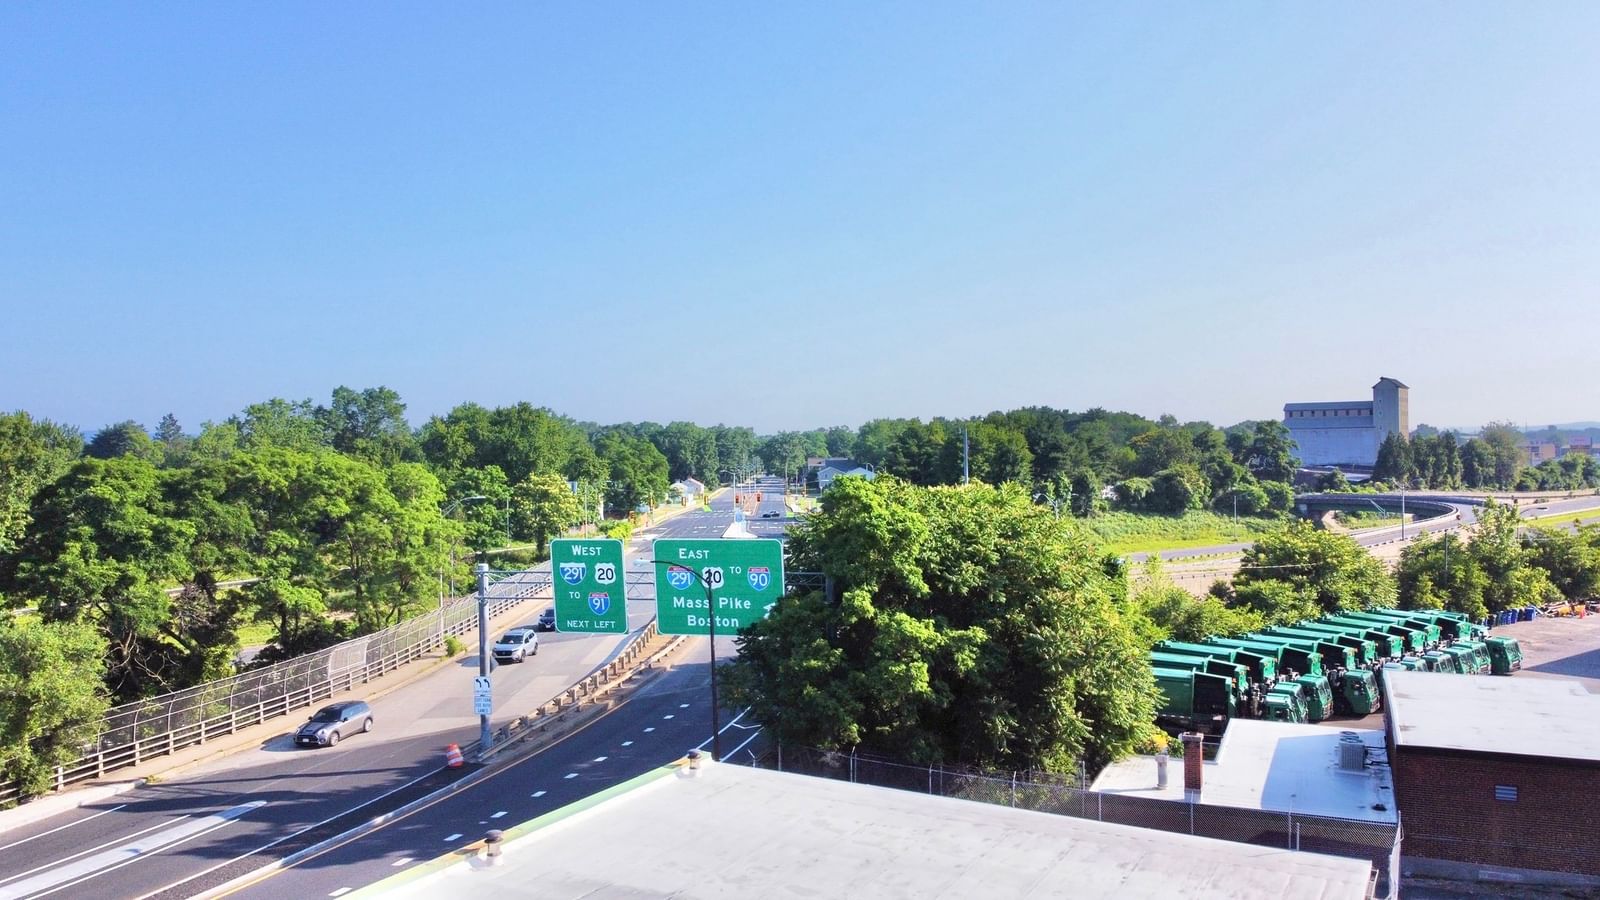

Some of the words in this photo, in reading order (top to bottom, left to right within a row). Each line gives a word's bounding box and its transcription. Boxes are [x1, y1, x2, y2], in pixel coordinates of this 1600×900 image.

[572, 544, 602, 556] WEST
[679, 548, 709, 559] EAST
[564, 567, 582, 580] 291
[597, 568, 614, 580] 20
[671, 572, 690, 585] 291
[750, 574, 768, 586] 90
[592, 598, 605, 610] 91
[673, 596, 709, 608] Mass
[719, 597, 751, 609] Pike
